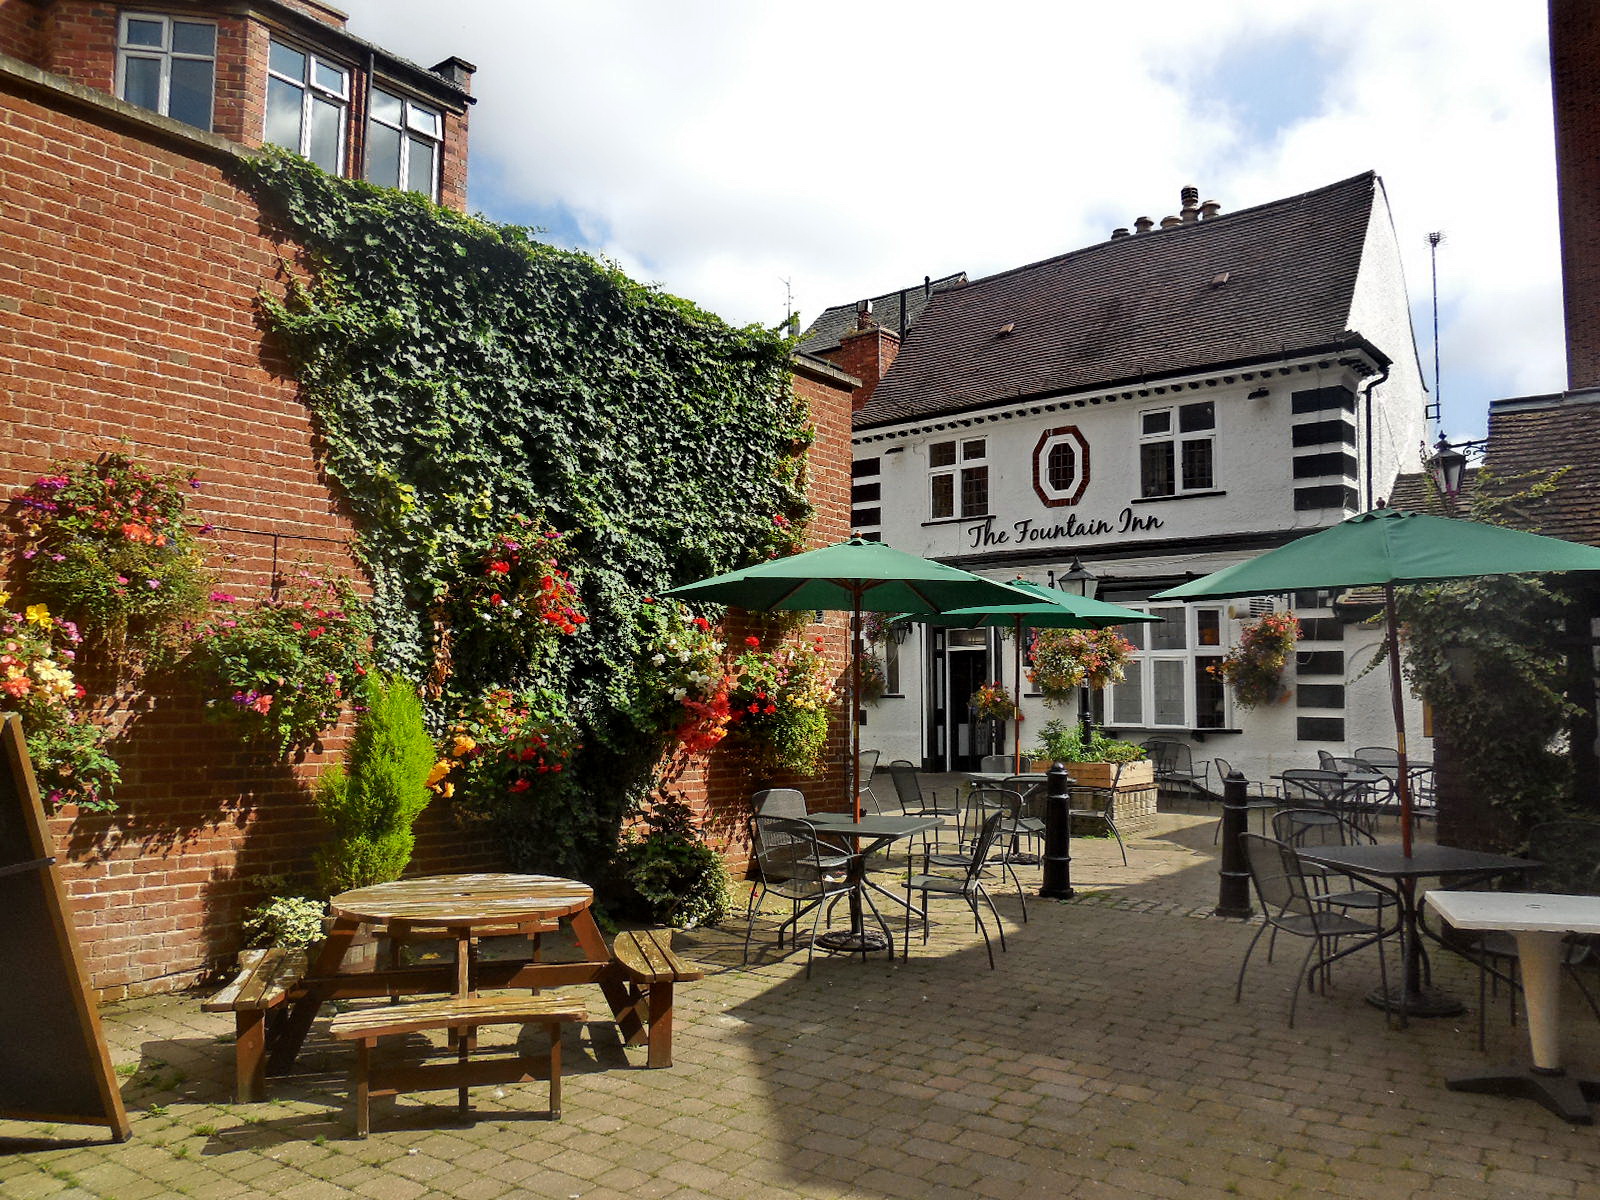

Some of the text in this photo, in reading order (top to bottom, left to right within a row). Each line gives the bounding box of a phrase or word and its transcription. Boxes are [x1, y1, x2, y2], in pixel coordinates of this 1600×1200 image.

[967, 507, 1164, 548] The Fountain Inn
